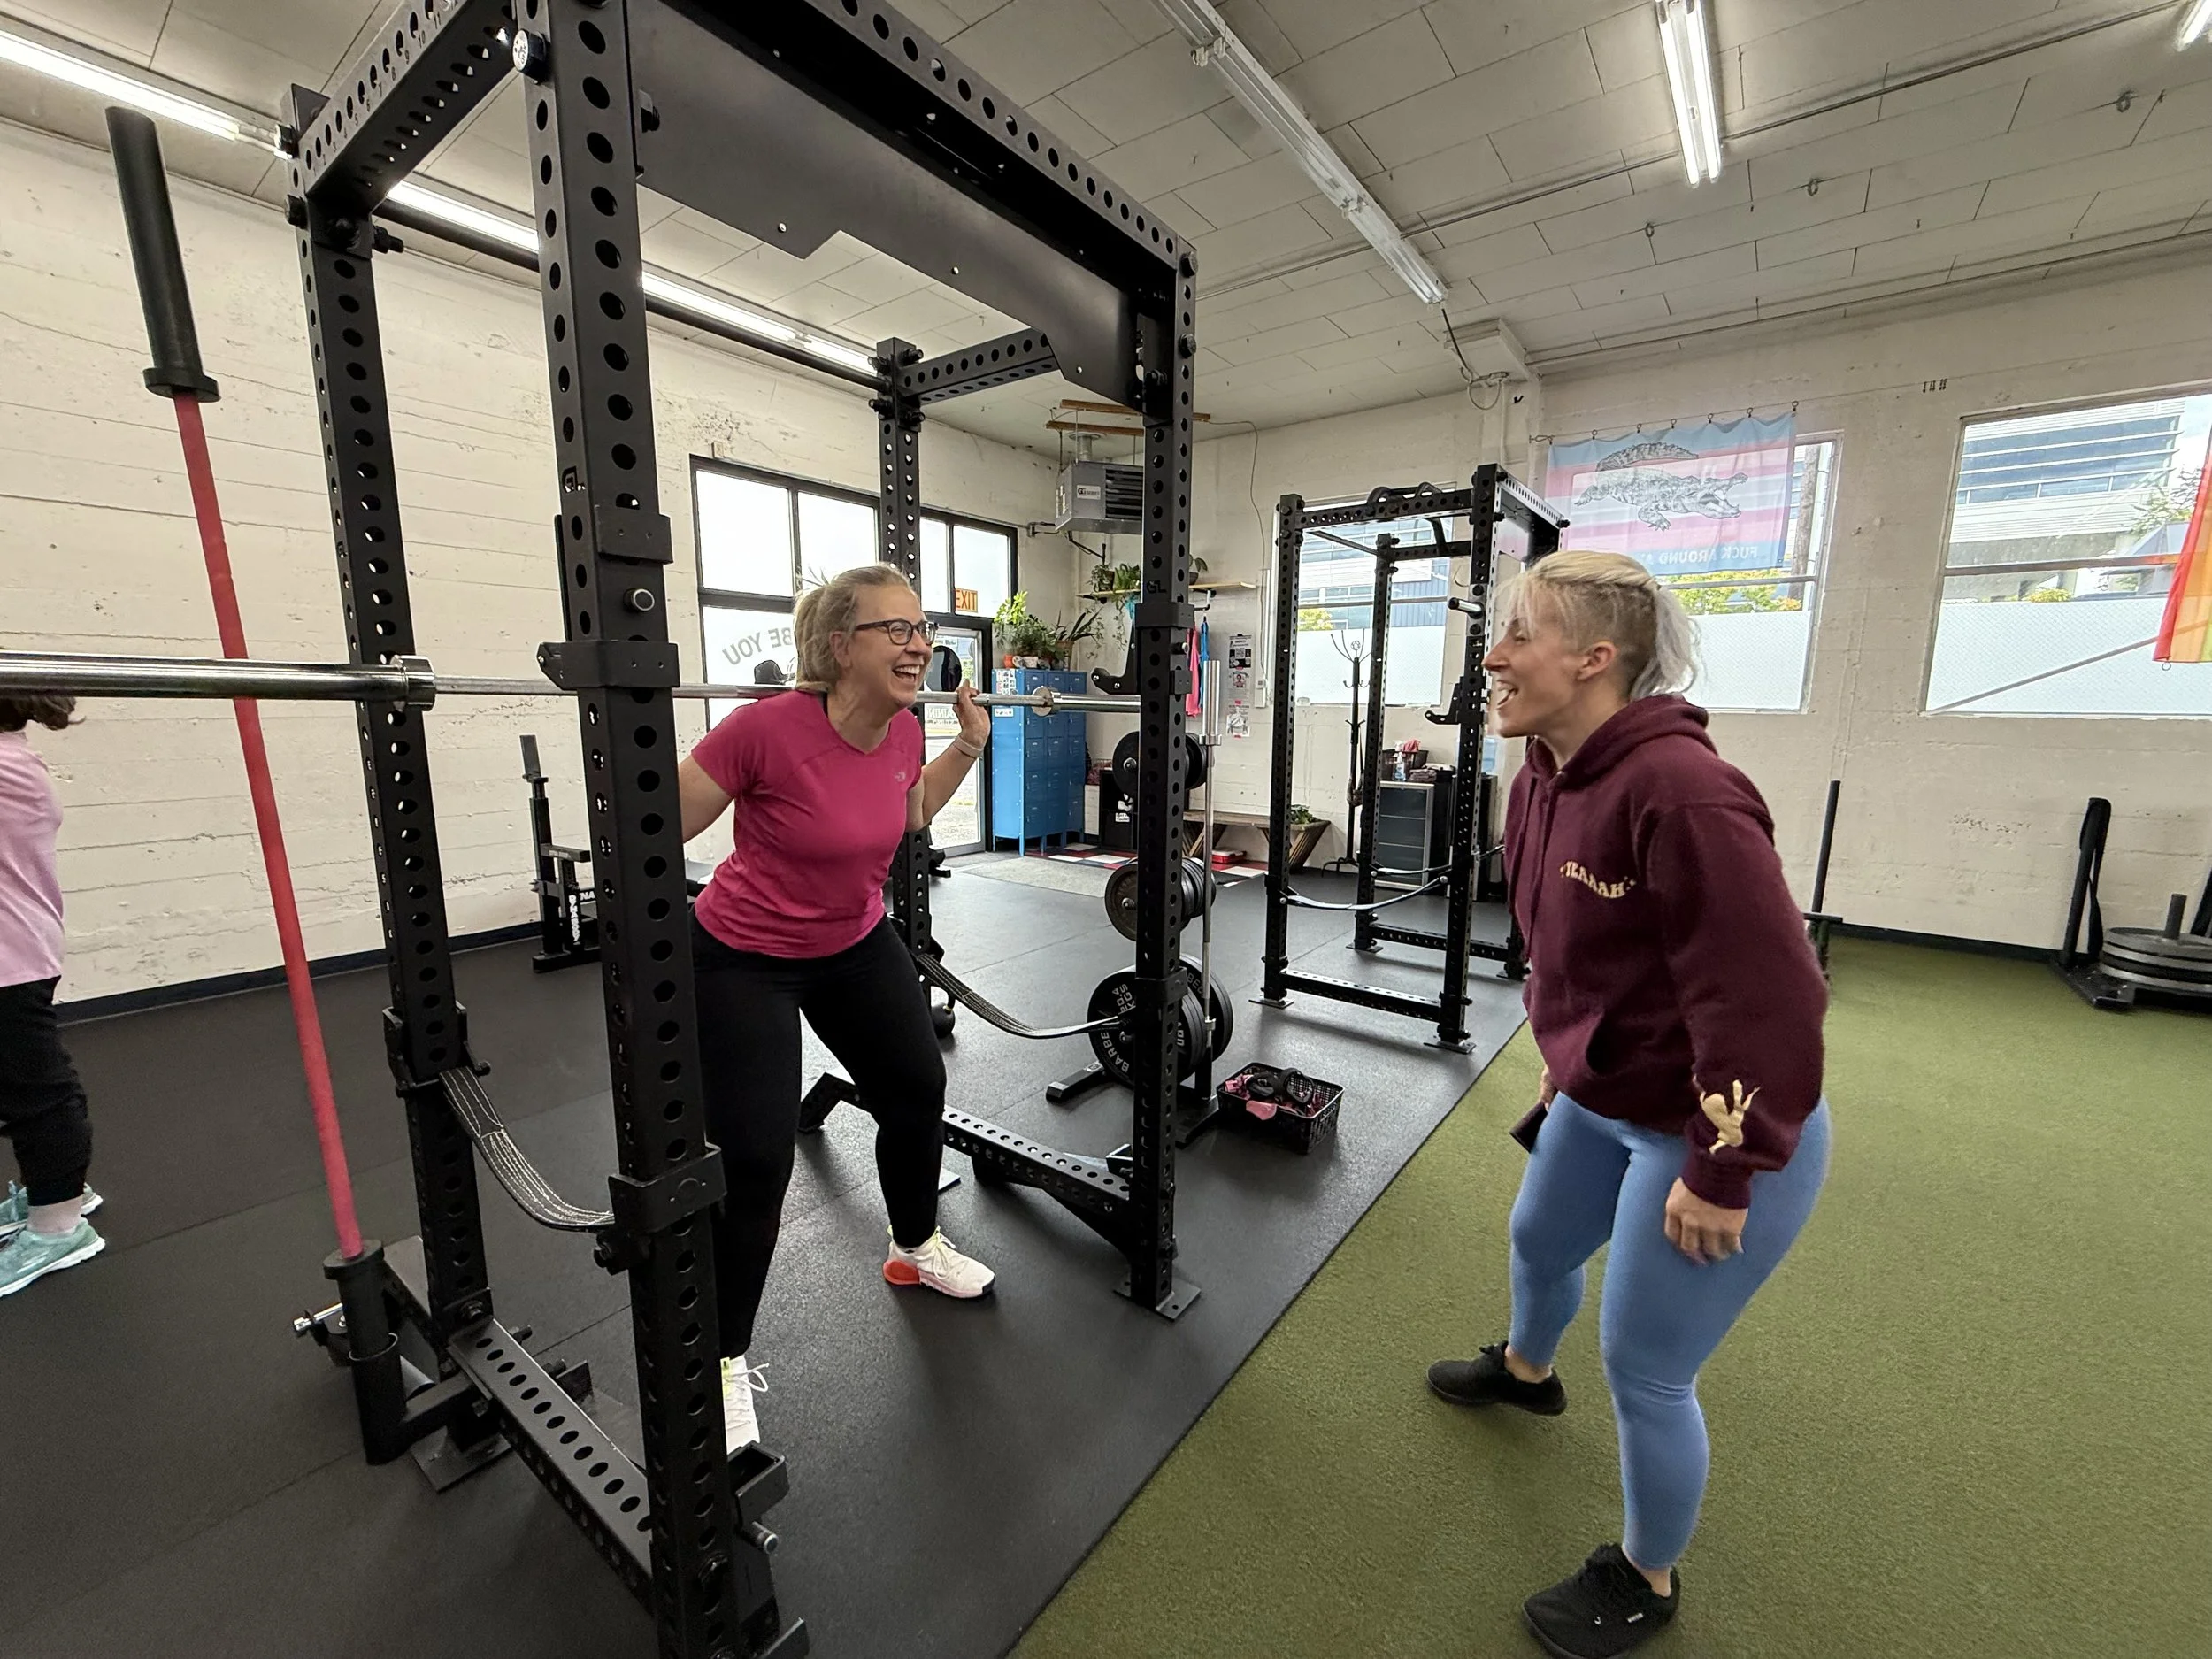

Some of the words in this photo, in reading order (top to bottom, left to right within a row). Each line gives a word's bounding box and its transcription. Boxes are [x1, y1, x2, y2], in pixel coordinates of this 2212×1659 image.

[418, 30, 426, 49] 10
[433, 11, 442, 30] 11
[956, 589, 977, 610] EXIT
[1100, 1032, 1130, 1073] BARBE
